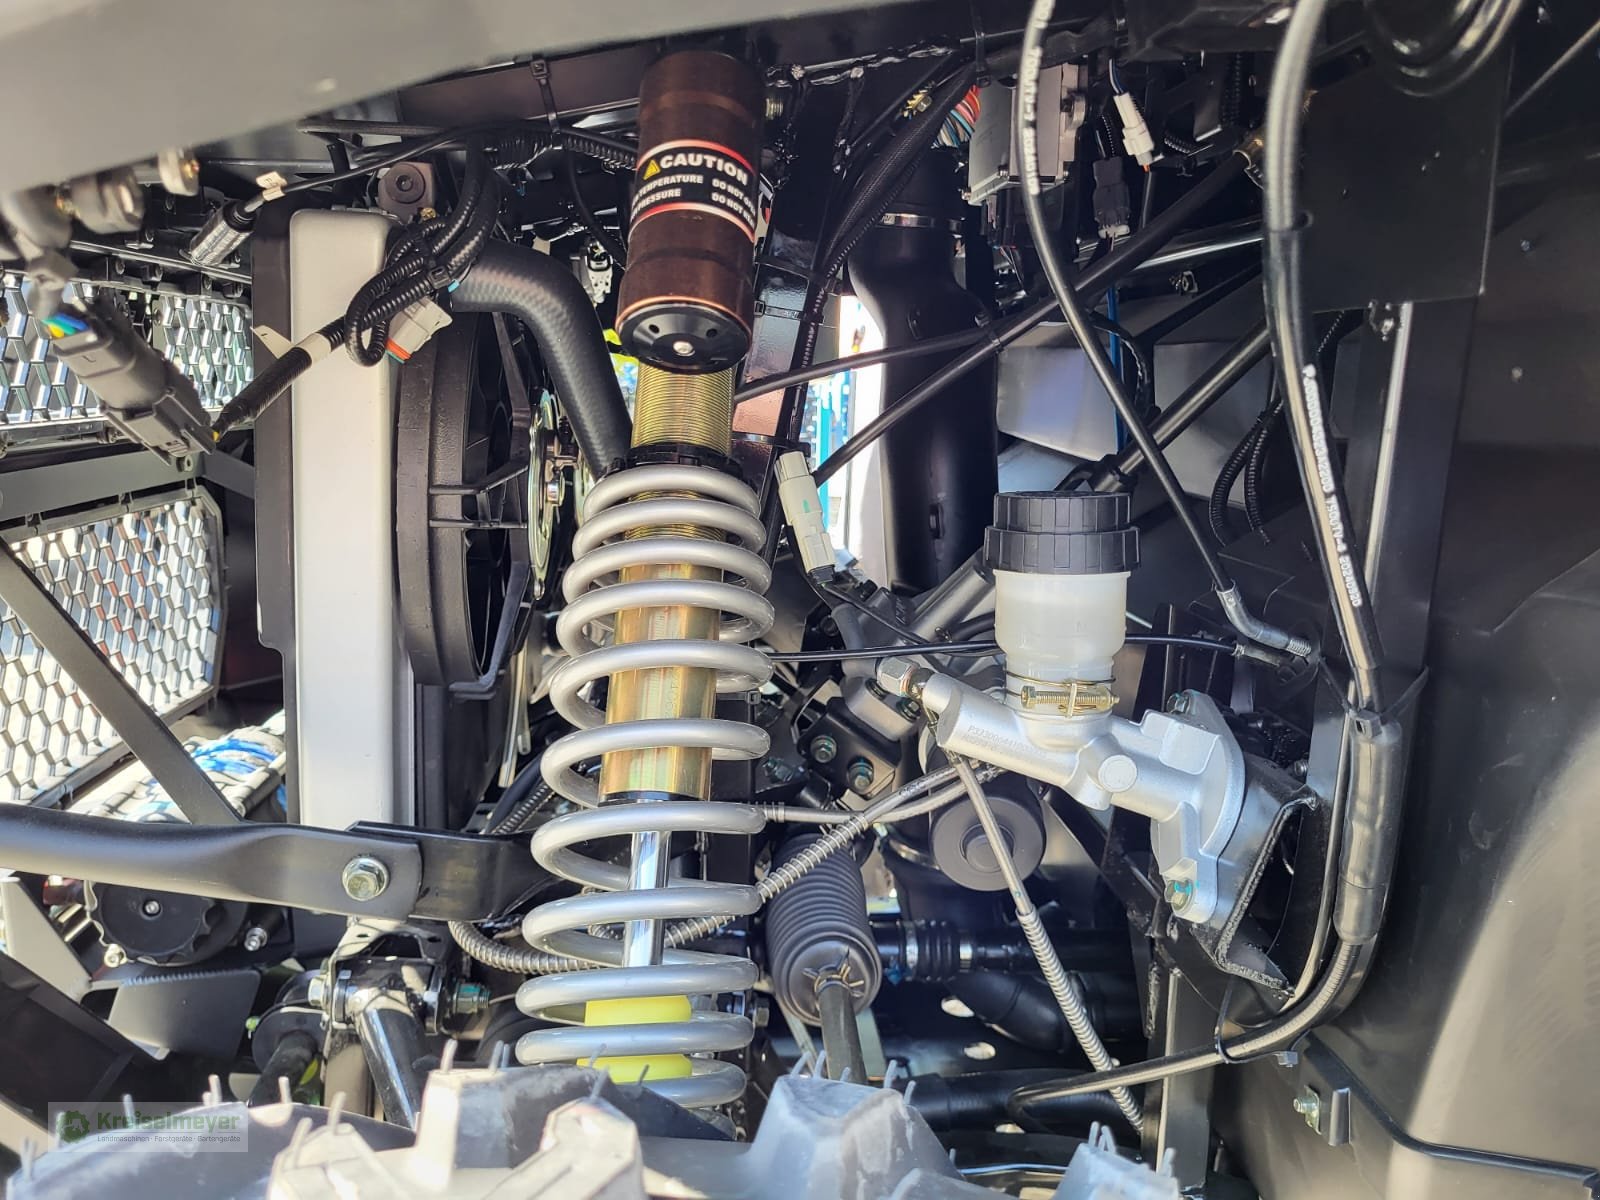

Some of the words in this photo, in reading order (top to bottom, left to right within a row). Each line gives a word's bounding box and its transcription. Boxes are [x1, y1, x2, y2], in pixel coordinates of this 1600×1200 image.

[660, 153, 748, 185] CAUTION
[638, 173, 704, 198] TEMPERATURE
[711, 178, 727, 190] DO
[726, 184, 744, 200] NOT
[711, 191, 726, 204] DO
[726, 198, 743, 214] NOT
